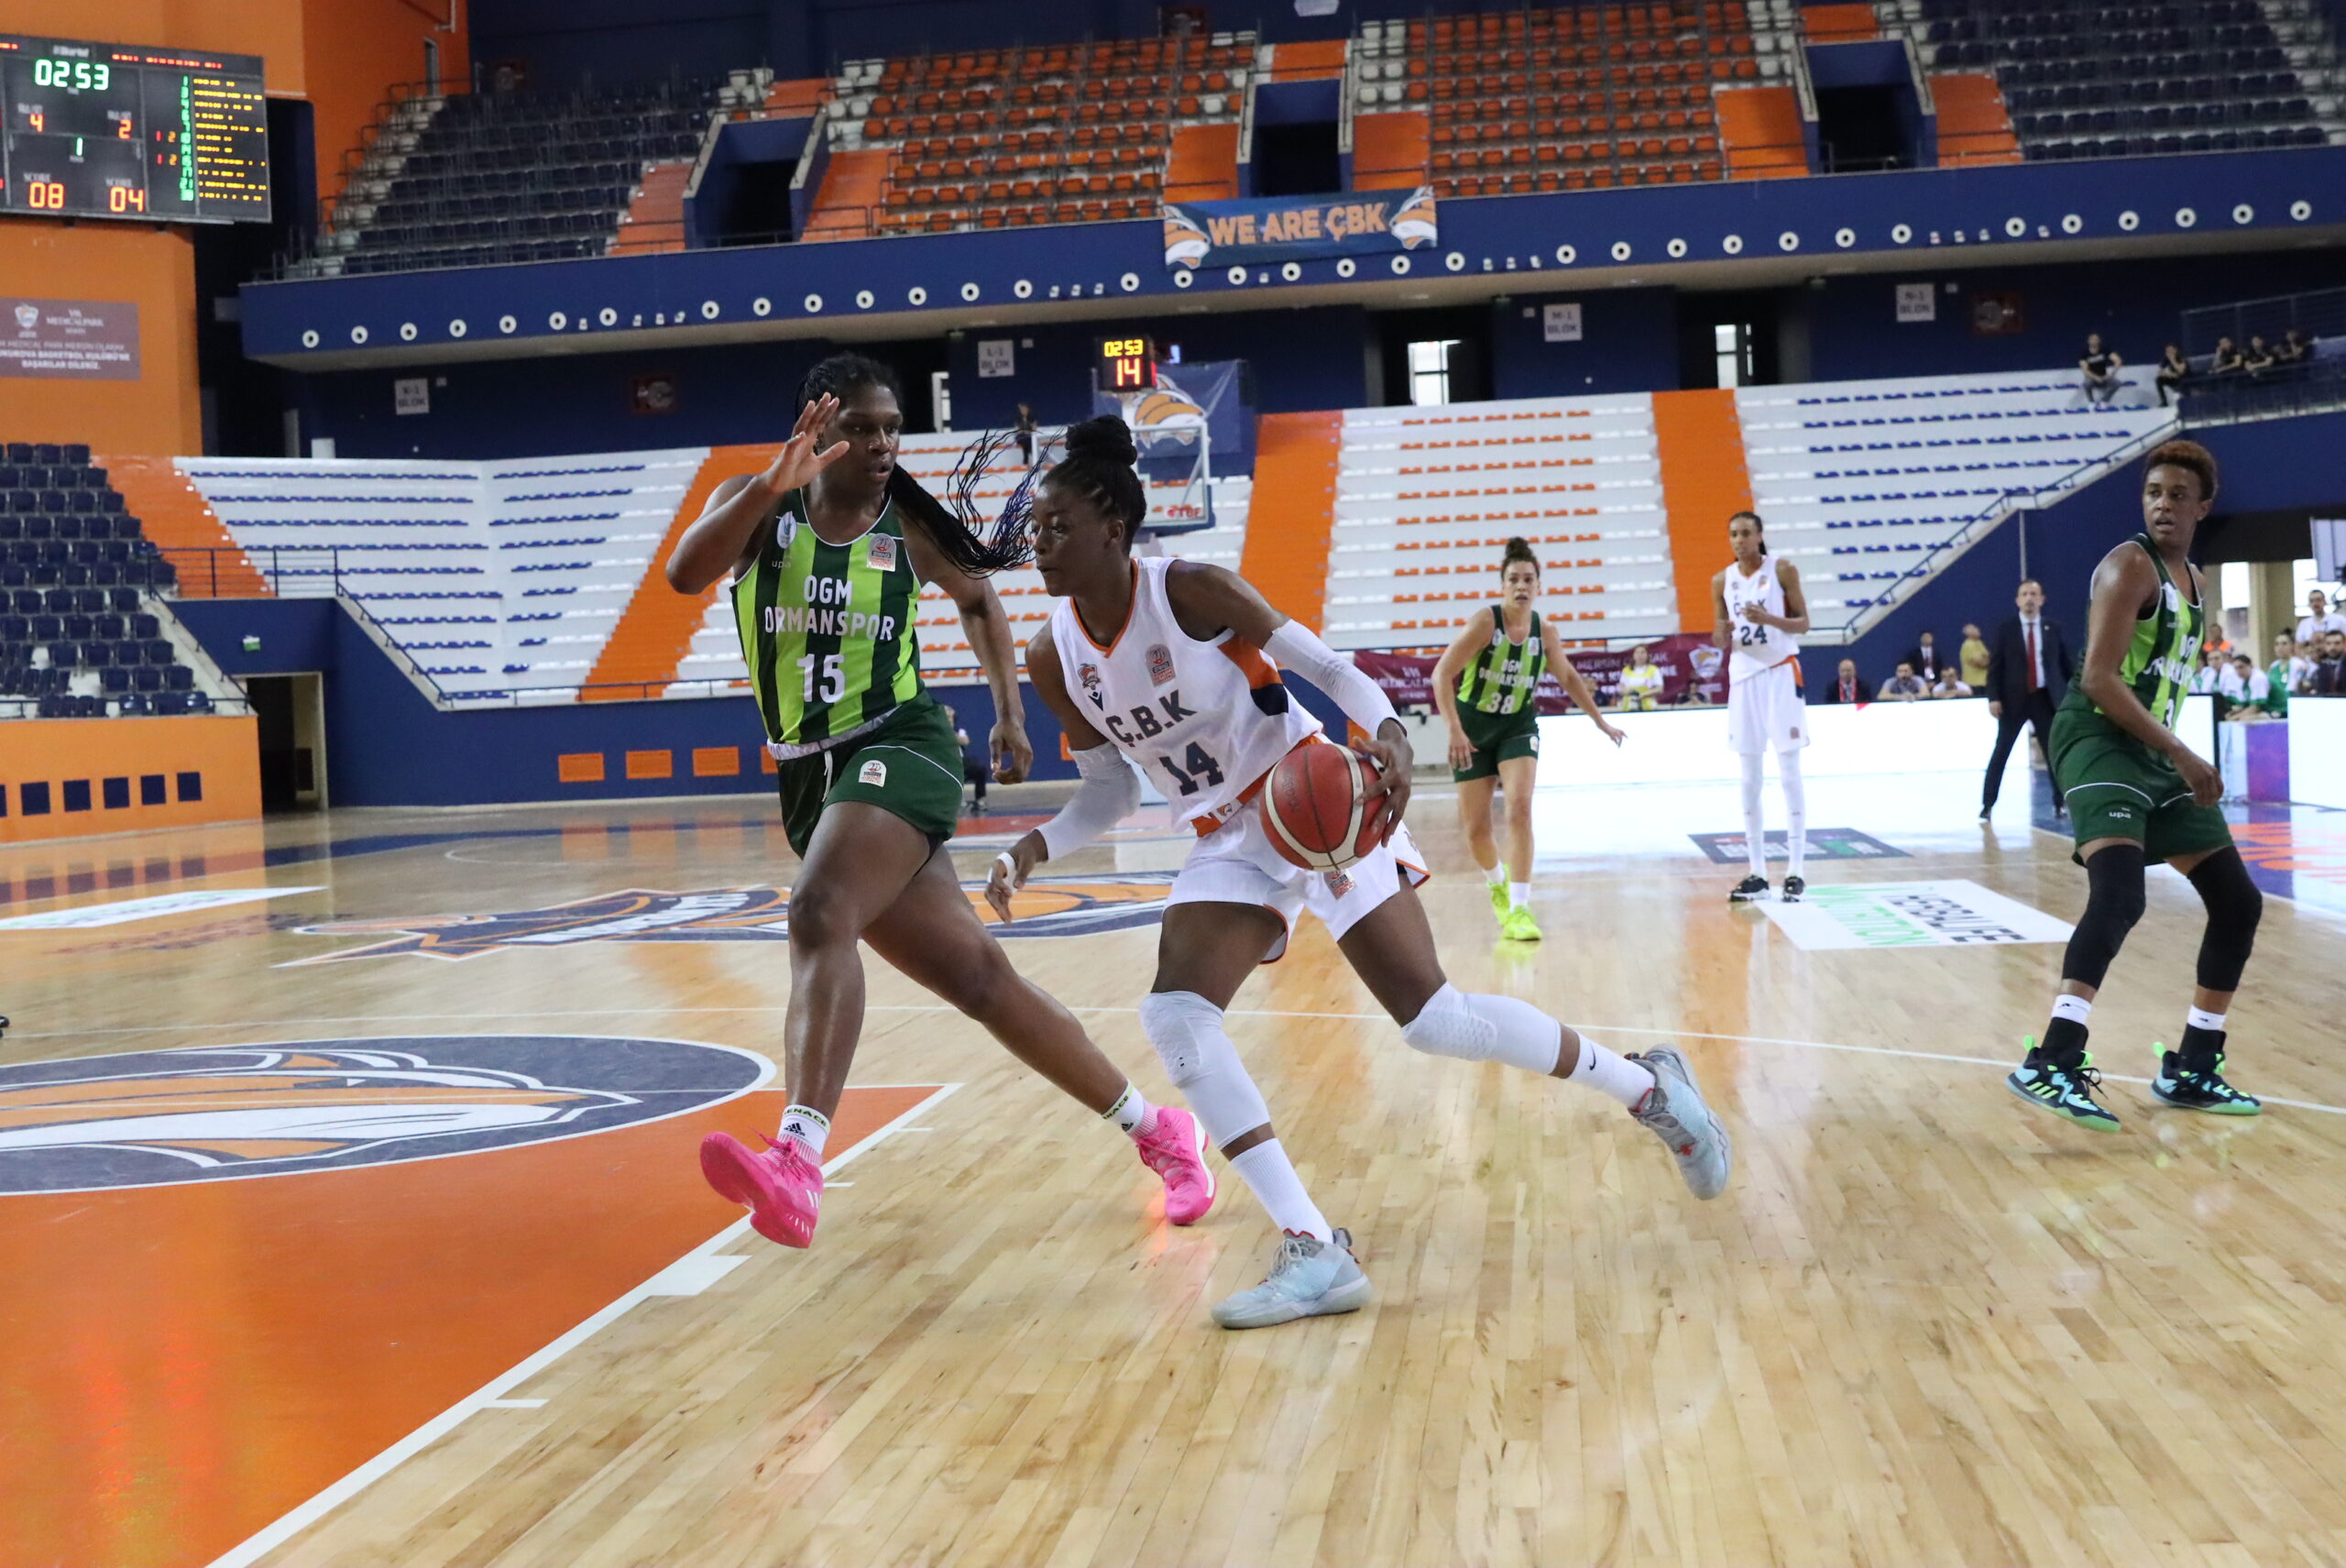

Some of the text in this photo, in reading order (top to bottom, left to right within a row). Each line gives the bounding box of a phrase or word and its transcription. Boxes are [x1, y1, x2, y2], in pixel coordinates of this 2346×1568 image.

[29, 113, 43, 133] 4
[118, 118, 132, 139] 2
[28, 181, 65, 210] 08
[110, 186, 145, 213] 04
[1206, 201, 1388, 247] WE ARE ÇBK
[1116, 357, 1141, 387] 14
[804, 575, 853, 606] OGM
[764, 605, 895, 641] ORMANSPOR
[1740, 625, 1768, 647] 24
[796, 652, 846, 703] 15
[1501, 659, 1523, 675] OGM
[1485, 692, 1516, 715] 38
[1105, 689, 1198, 748] Ç.B.K
[1158, 740, 1224, 796] 14
